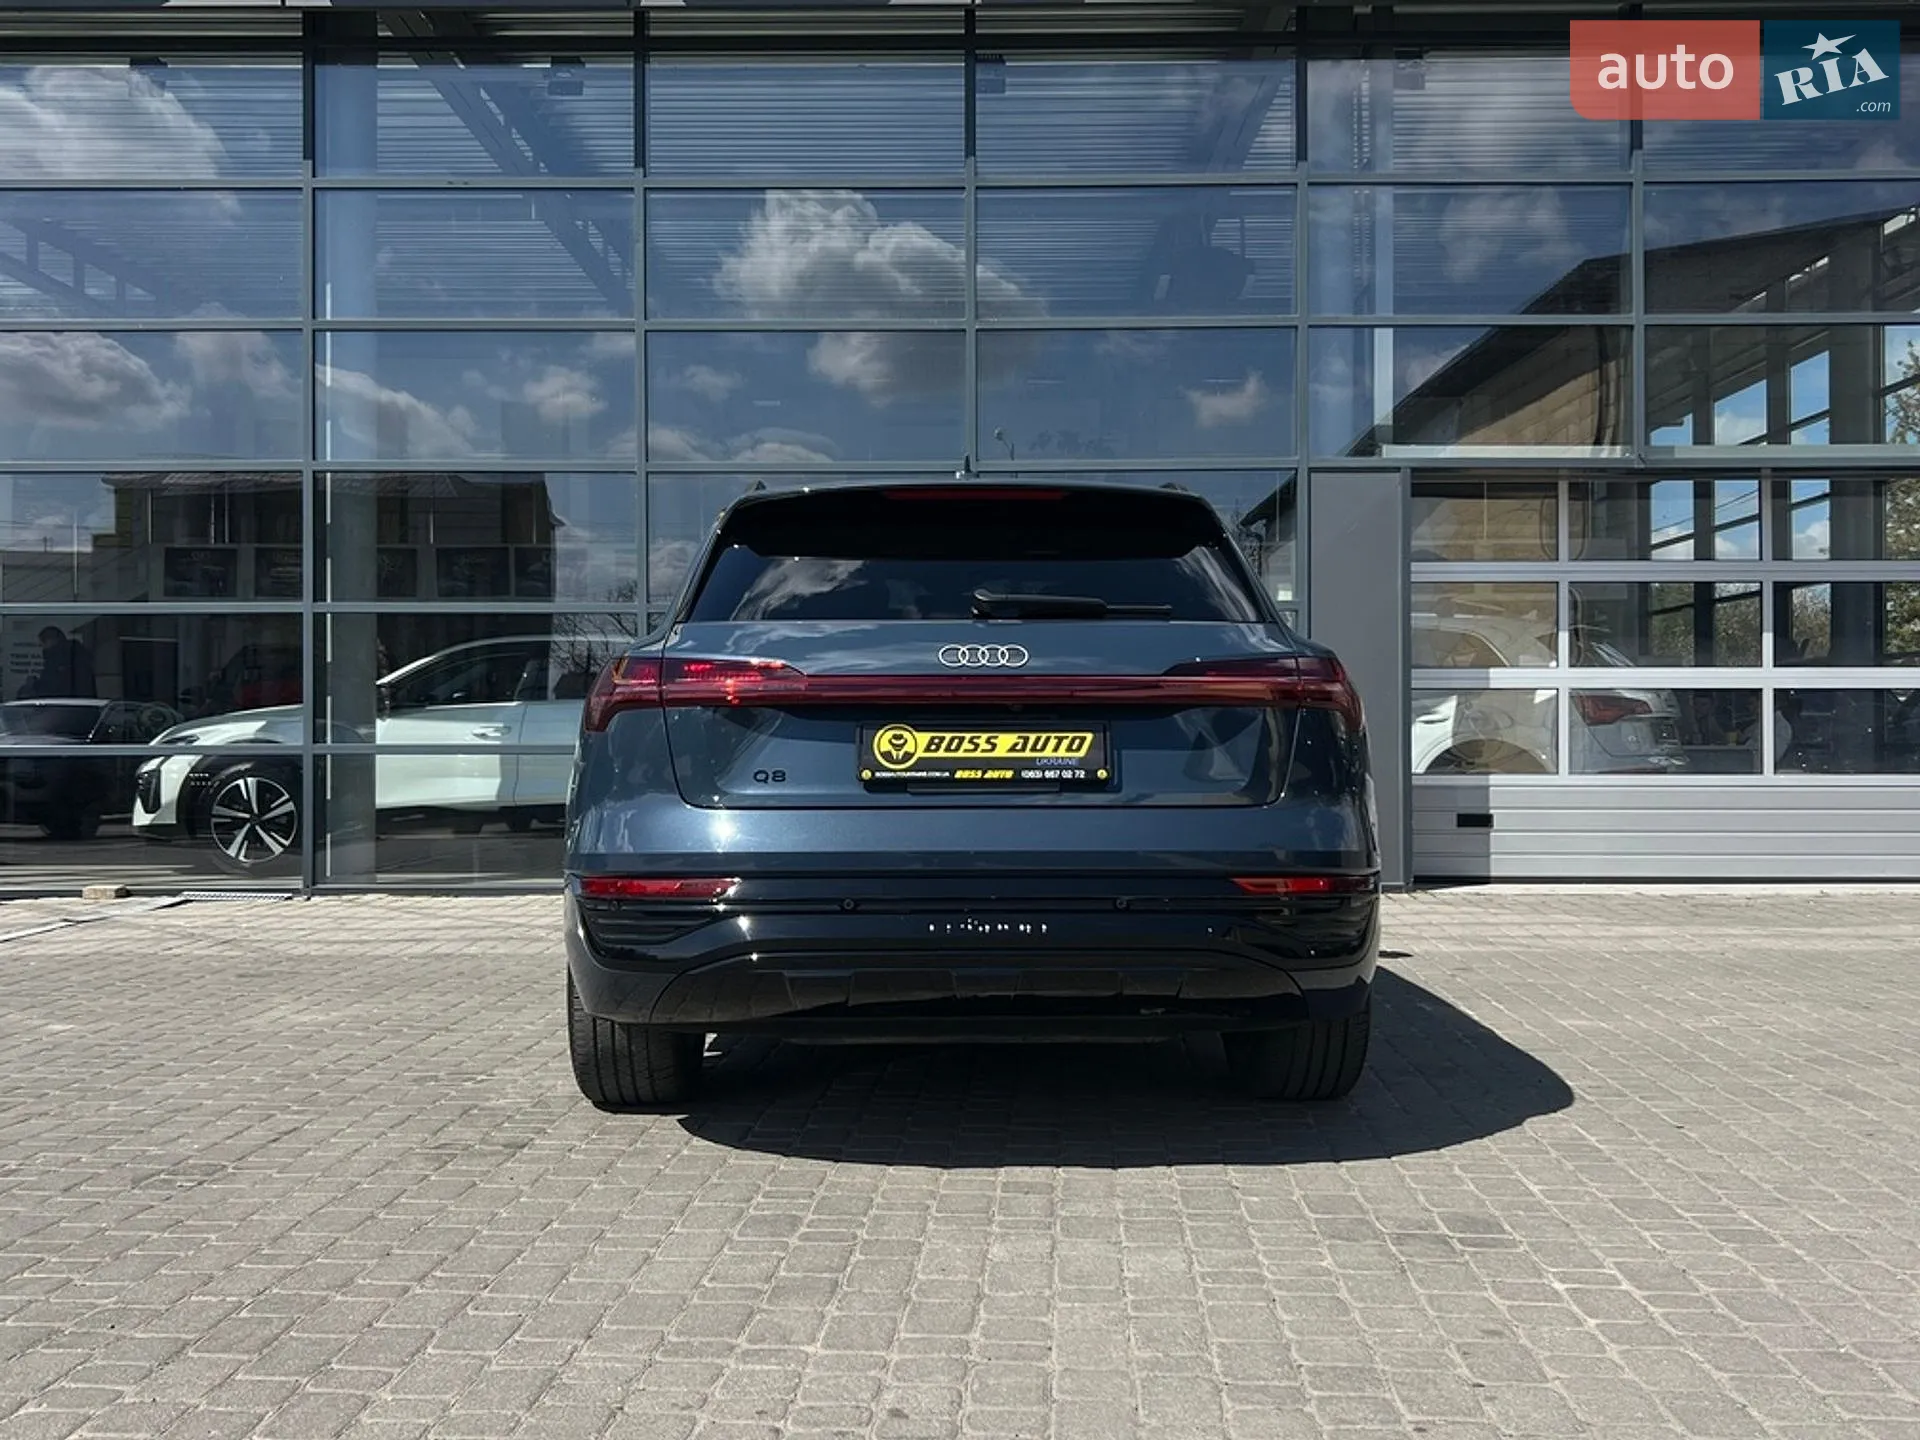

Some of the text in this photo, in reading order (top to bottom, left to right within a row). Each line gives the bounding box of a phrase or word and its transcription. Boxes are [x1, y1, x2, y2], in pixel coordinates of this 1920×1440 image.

[923, 735, 1088, 754] BOSS AUTO
[753, 769, 786, 784] Q8
[954, 769, 982, 778] BOSS
